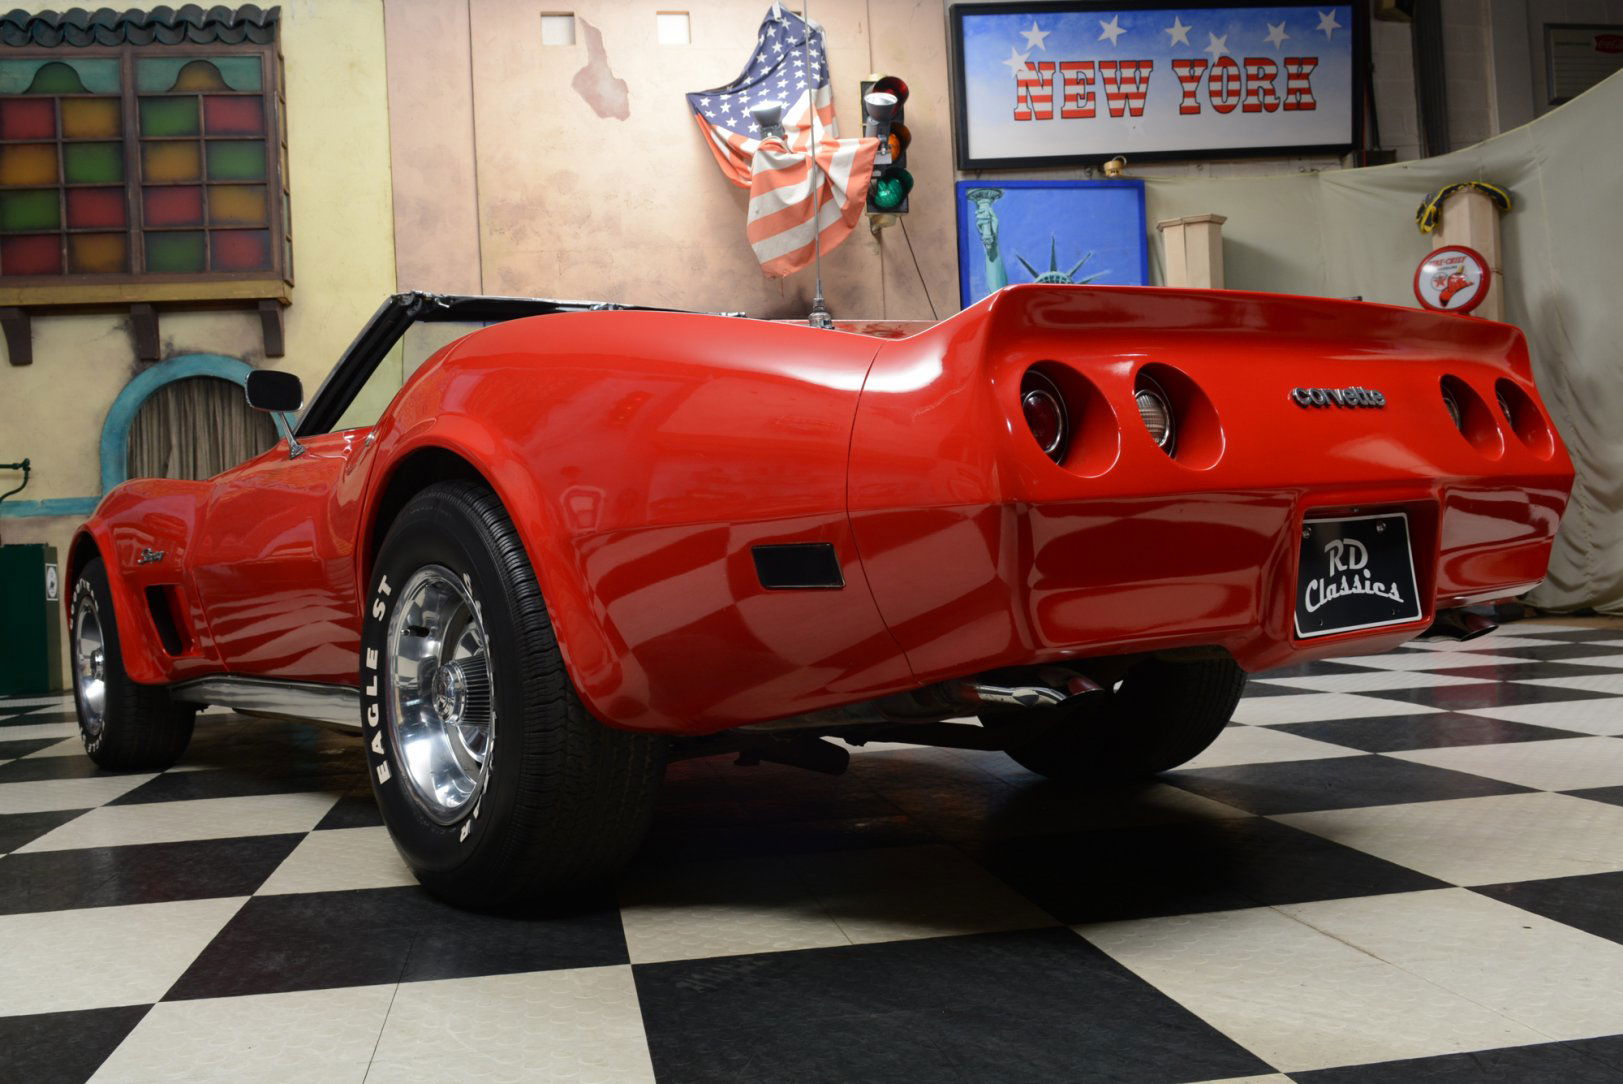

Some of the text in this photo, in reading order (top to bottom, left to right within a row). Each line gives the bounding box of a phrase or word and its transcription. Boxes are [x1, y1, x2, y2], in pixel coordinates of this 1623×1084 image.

[1014, 56, 1319, 121] NEW YORK
[1324, 538, 1369, 577] RD
[1305, 568, 1404, 613] Classics
[366, 575, 392, 785] EAGLE ST
